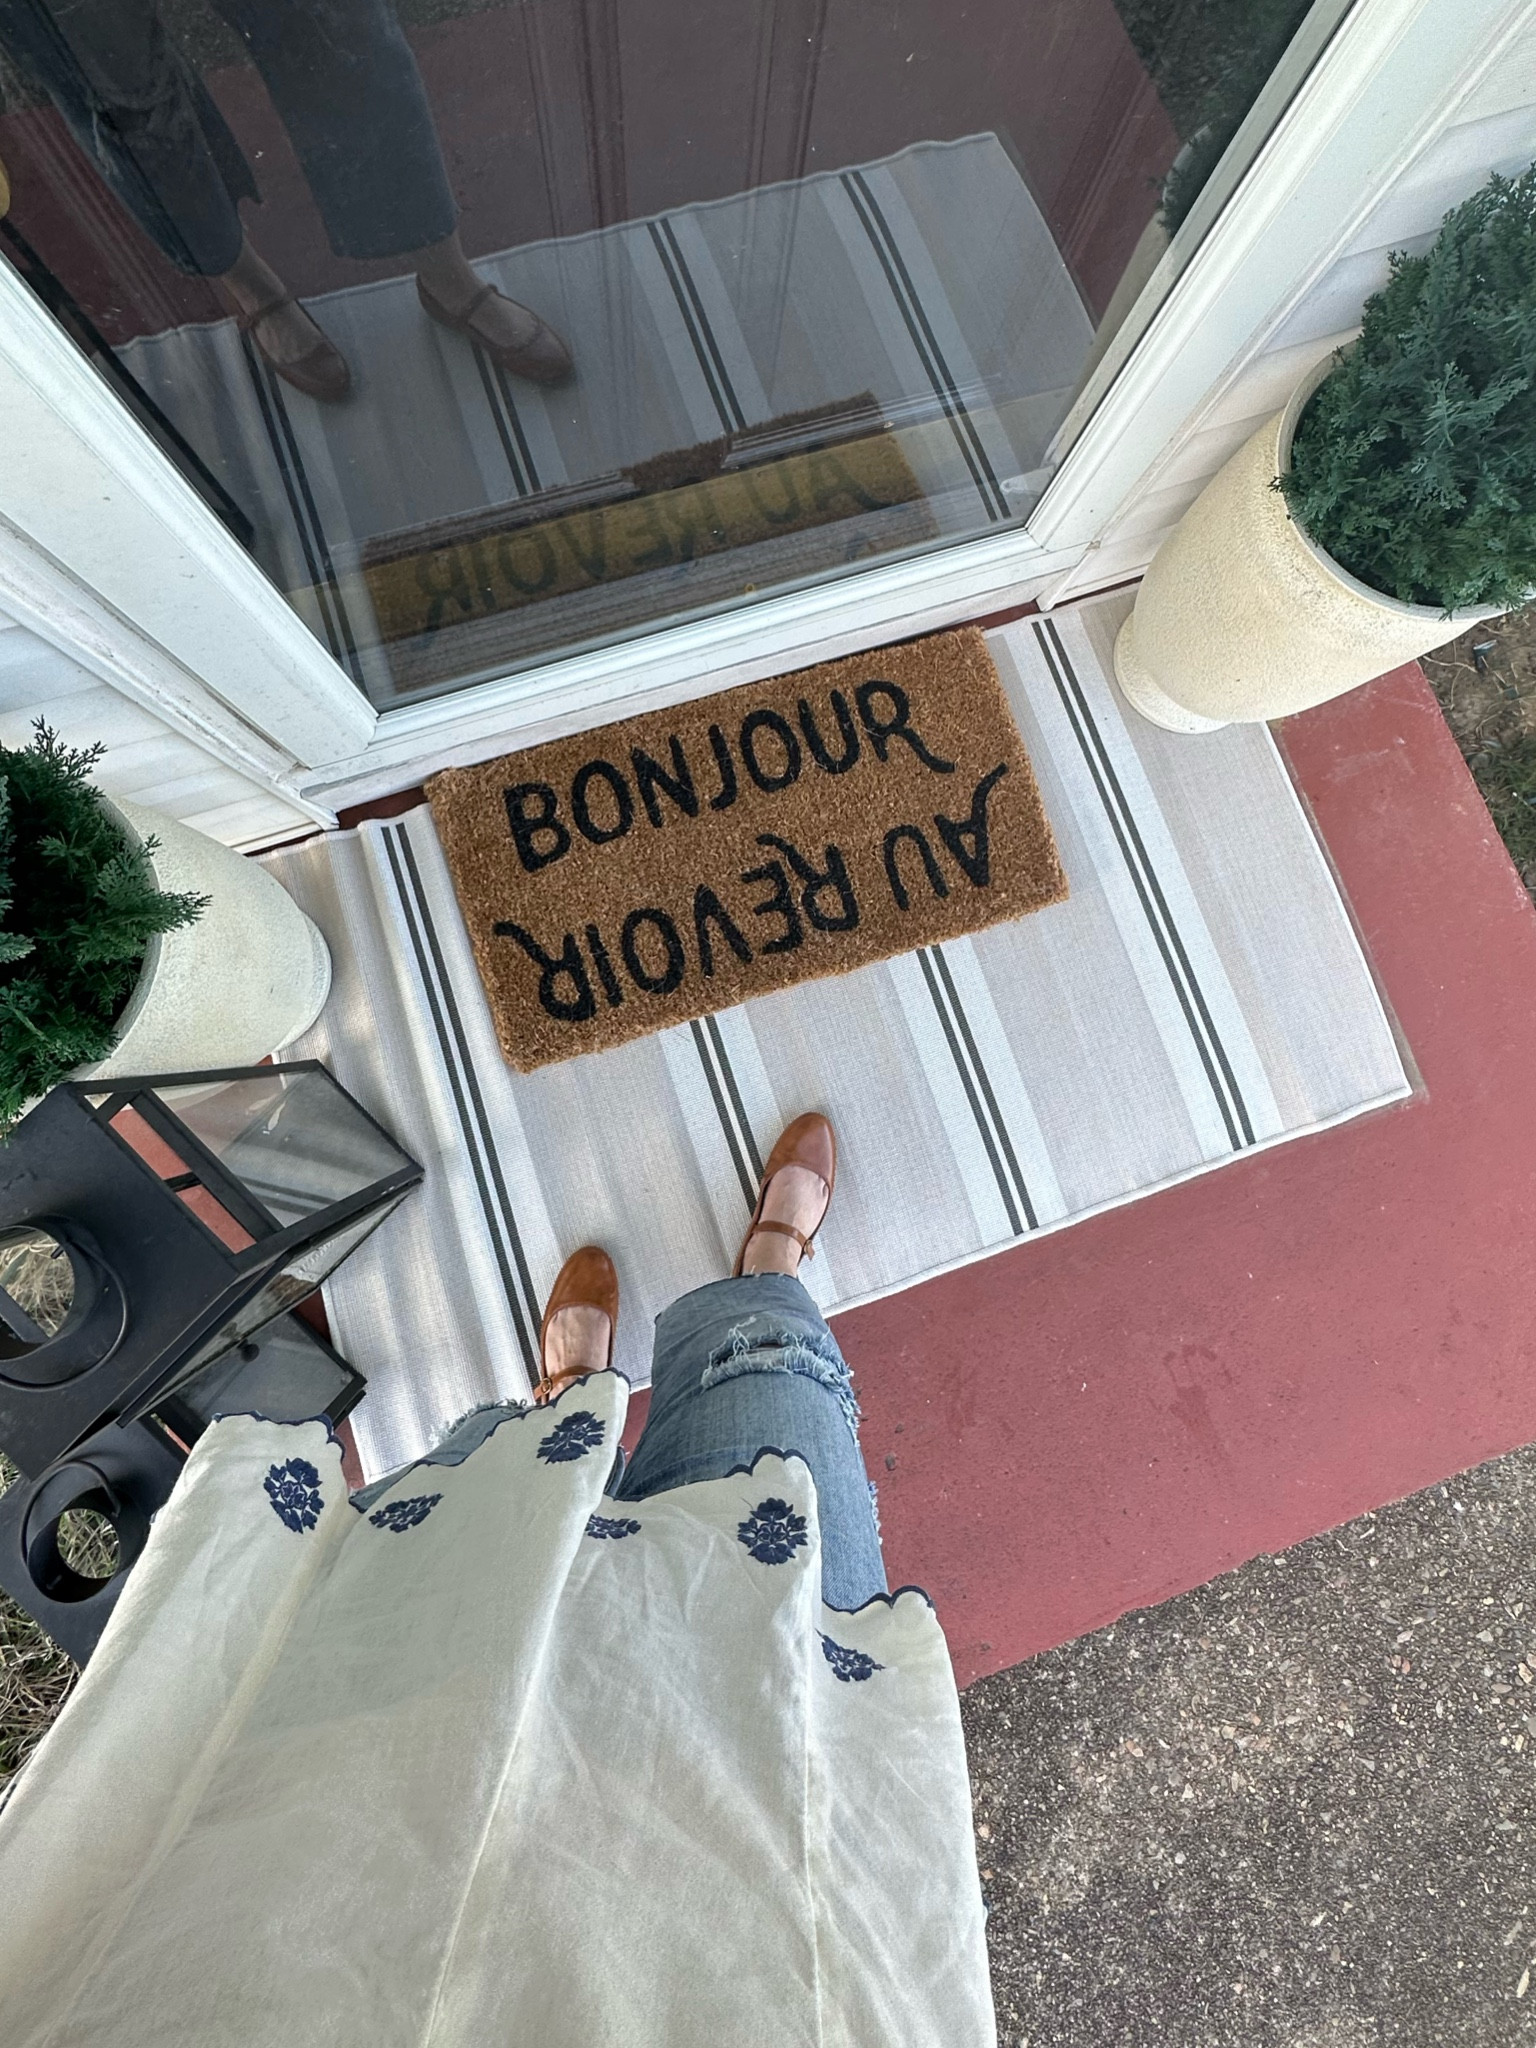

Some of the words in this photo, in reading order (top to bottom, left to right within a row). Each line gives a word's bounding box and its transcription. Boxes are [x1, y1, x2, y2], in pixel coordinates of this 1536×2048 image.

[504, 680, 956, 872] BONJOUR
[884, 763, 1007, 911] AU
[494, 834, 859, 1022] REVOIR
